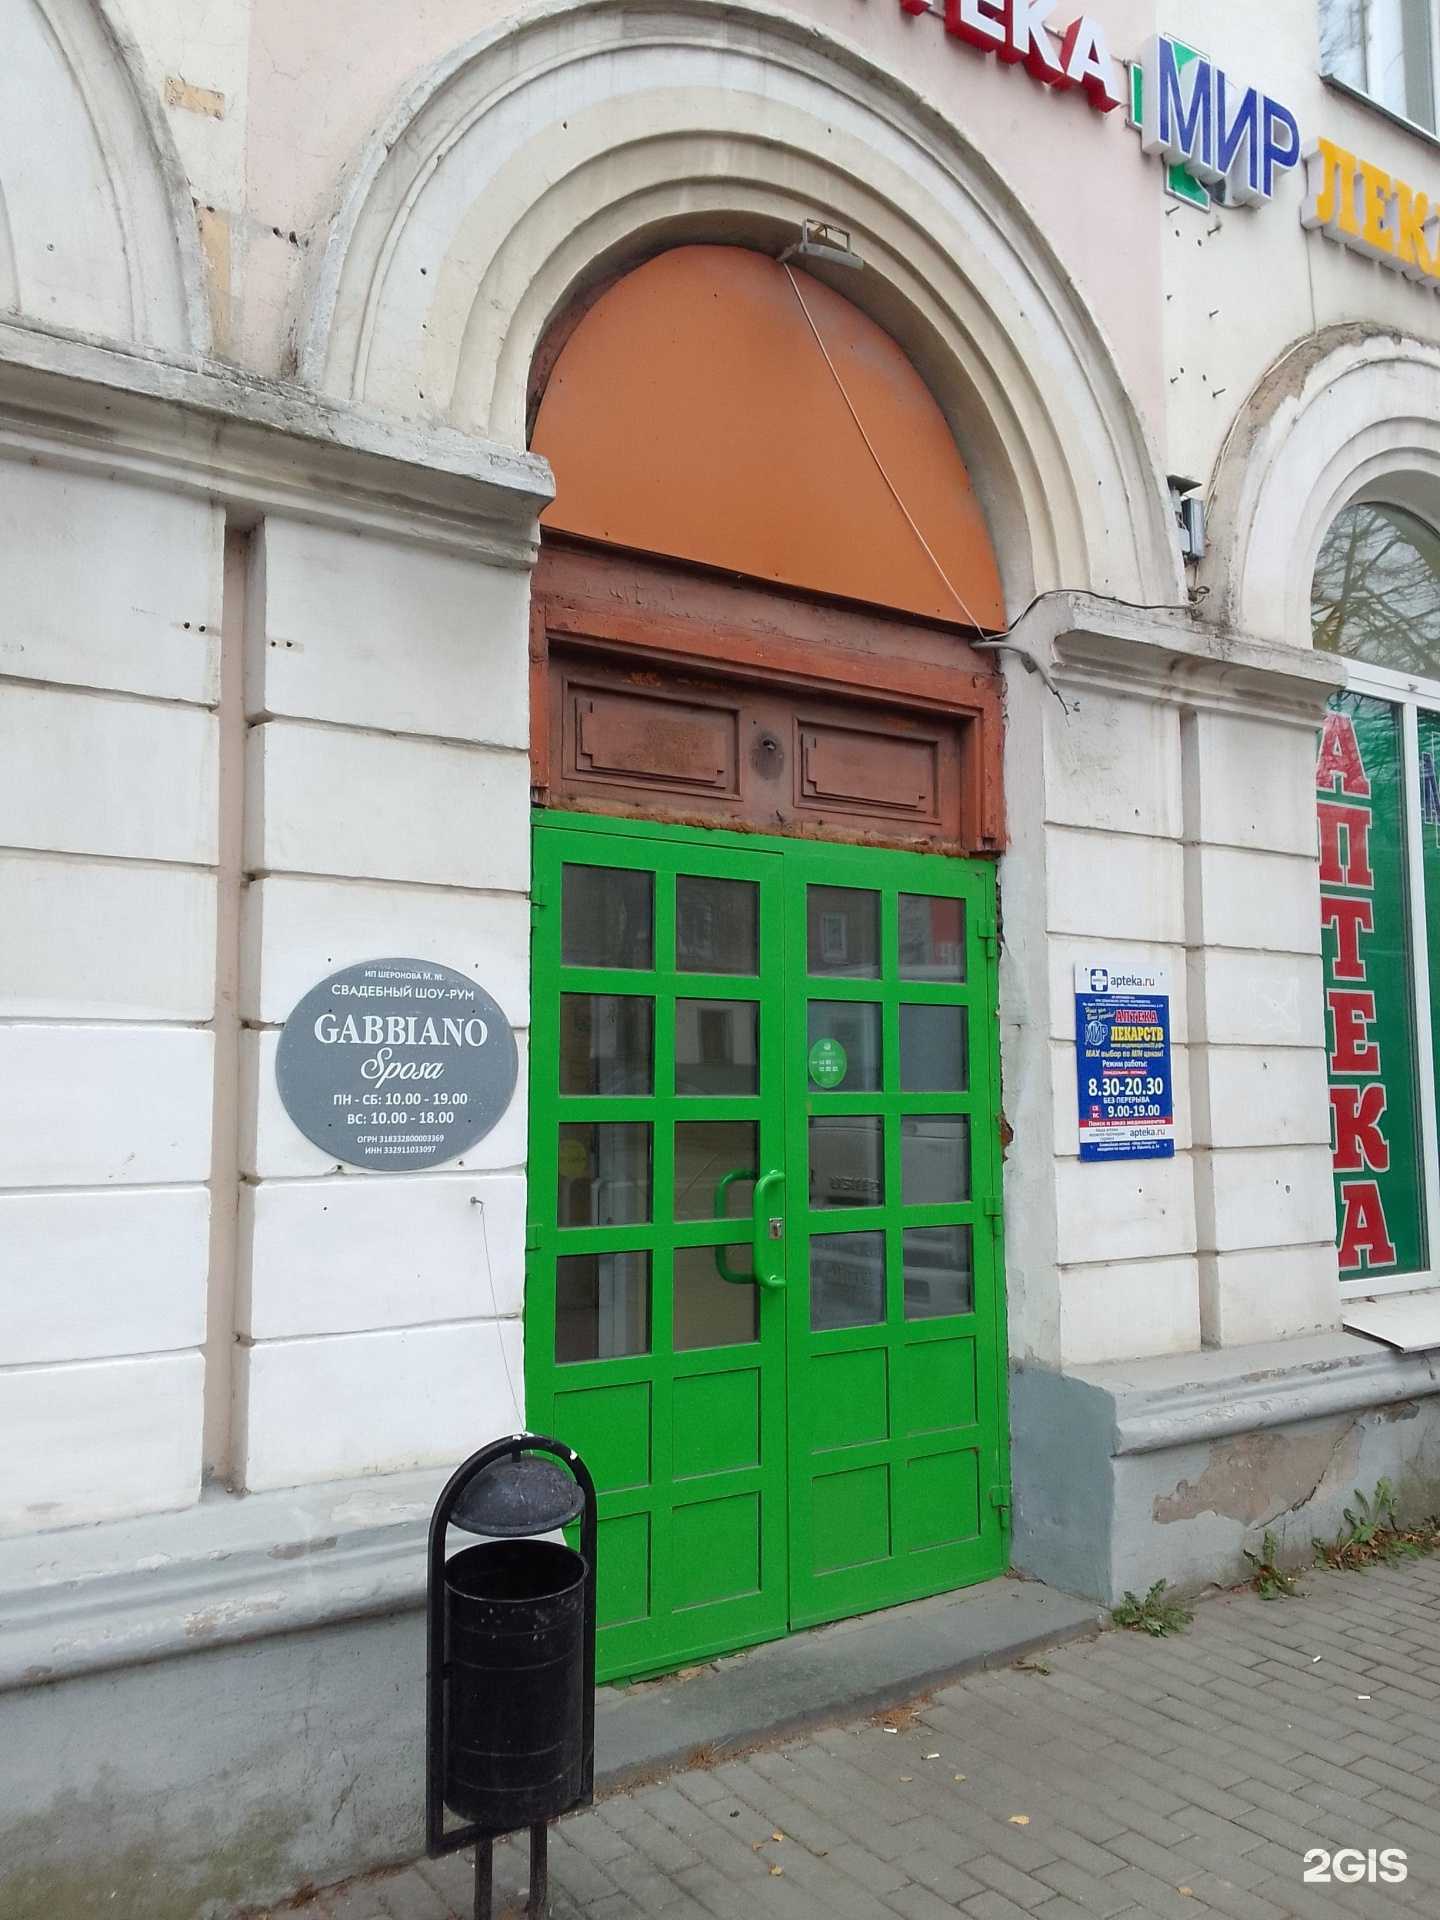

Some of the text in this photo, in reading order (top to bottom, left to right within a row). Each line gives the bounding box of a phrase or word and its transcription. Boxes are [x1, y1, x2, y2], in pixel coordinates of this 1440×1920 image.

[1155, 33, 1301, 202] МИР
[1313, 135, 1440, 281] ЛЕК
[364, 970, 377, 978] ИП
[378, 970, 421, 980] ШЕРОНОВА
[1110, 974, 1155, 988] apteka.ru
[331, 984, 475, 1001] СВАДЕБНЫЙ ШОУ-РУМ
[1315, 710, 1396, 1270] АПТЕКА
[1115, 1009, 1159, 1024] АПТЕКА
[313, 1013, 489, 1048] GABBIANO
[1110, 1026, 1164, 1042] ЛЕКАРСТВ
[360, 1046, 446, 1089] Sposa
[1088, 1077, 1163, 1096] 8.30-20.30
[333, 1094, 352, 1105] ПН
[362, 1094, 382, 1105] СБ:
[385, 1092, 421, 1105] 10.00
[432, 1092, 468, 1105] 19.00
[1116, 1096, 1150, 1104] ПЕРЕРЫВА
[347, 1113, 367, 1124] ВС:
[370, 1111, 407, 1124] 10.00
[418, 1111, 455, 1124] 18.00
[1107, 1104, 1160, 1117] 9.00-19.00
[356, 1135, 378, 1143] ОГРН
[1129, 1127, 1166, 1138] apteka.ru
[365, 1146, 382, 1154] ИНН
